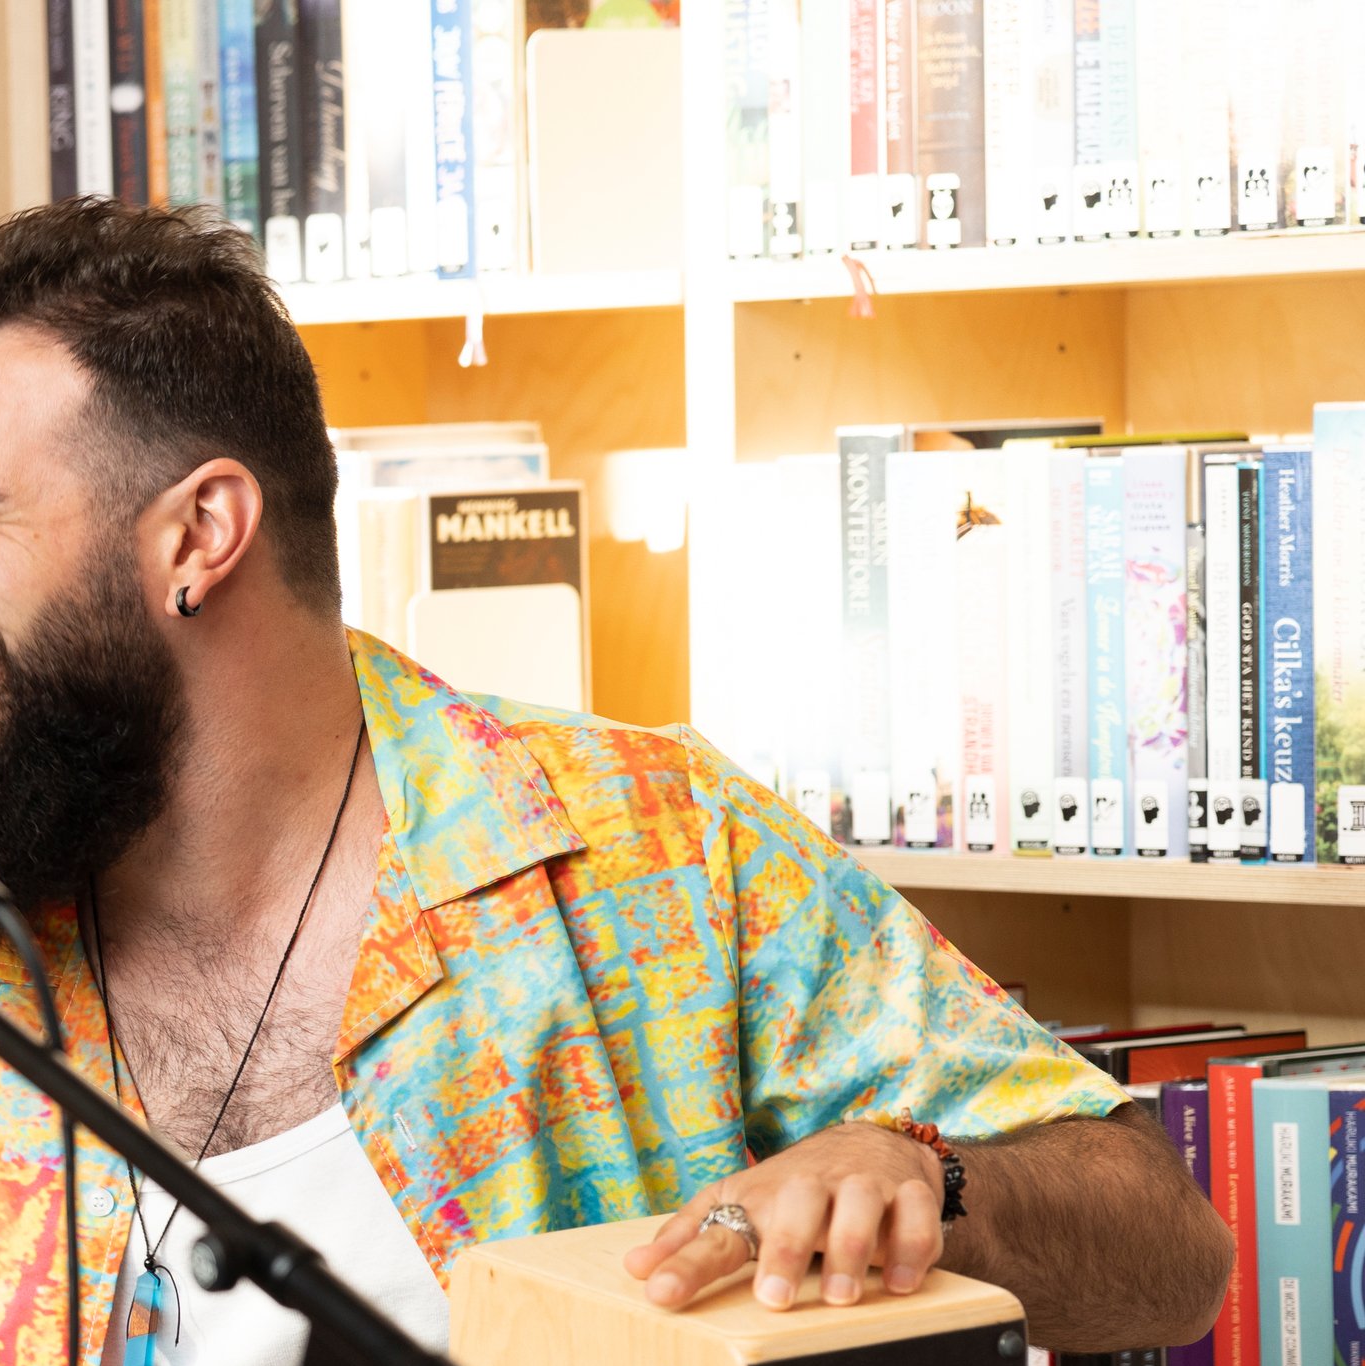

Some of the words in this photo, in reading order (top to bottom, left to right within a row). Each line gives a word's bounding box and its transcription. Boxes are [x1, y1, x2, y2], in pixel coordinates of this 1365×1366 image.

[268, 41, 293, 141] Scherven
[1083, 67, 1101, 164] HALFBROE
[271, 146, 290, 183] van
[1331, 447, 1350, 478] De
[1241, 491, 1251, 519] TONI
[1276, 468, 1296, 530] Heather
[1331, 483, 1351, 536] dochter
[436, 508, 576, 543] MANKELL
[846, 452, 869, 616] MONTEFIORE
[872, 502, 888, 566] SIMON
[1102, 510, 1119, 579] SARAH
[1213, 561, 1229, 584] DE
[1277, 535, 1296, 587] Morris
[1332, 540, 1346, 567] van
[1332, 572, 1349, 591] de
[1060, 599, 1075, 630] Van
[1241, 602, 1253, 640] GOD
[1057, 635, 1075, 682] vogels
[1213, 591, 1230, 719] POMPOENETER
[1241, 644, 1253, 676] STA
[1271, 617, 1303, 710] Cilka's
[1332, 596, 1351, 705] klokkenmaker
[1060, 688, 1074, 709] en
[1097, 677, 1115, 698] de
[1241, 680, 1253, 714] HET
[1241, 718, 1253, 761] KIND
[1273, 718, 1303, 784] keuz
[1224, 1075, 1236, 1115] ALICE
[1182, 1105, 1197, 1142] Alice
[1225, 1118, 1237, 1169] MUNRO
[1343, 1111, 1358, 1151] HARUKI
[1225, 1173, 1240, 1229] Levens
[1279, 1167, 1295, 1221] MURAKAMI
[1345, 1155, 1359, 1214] MURAKAMI
